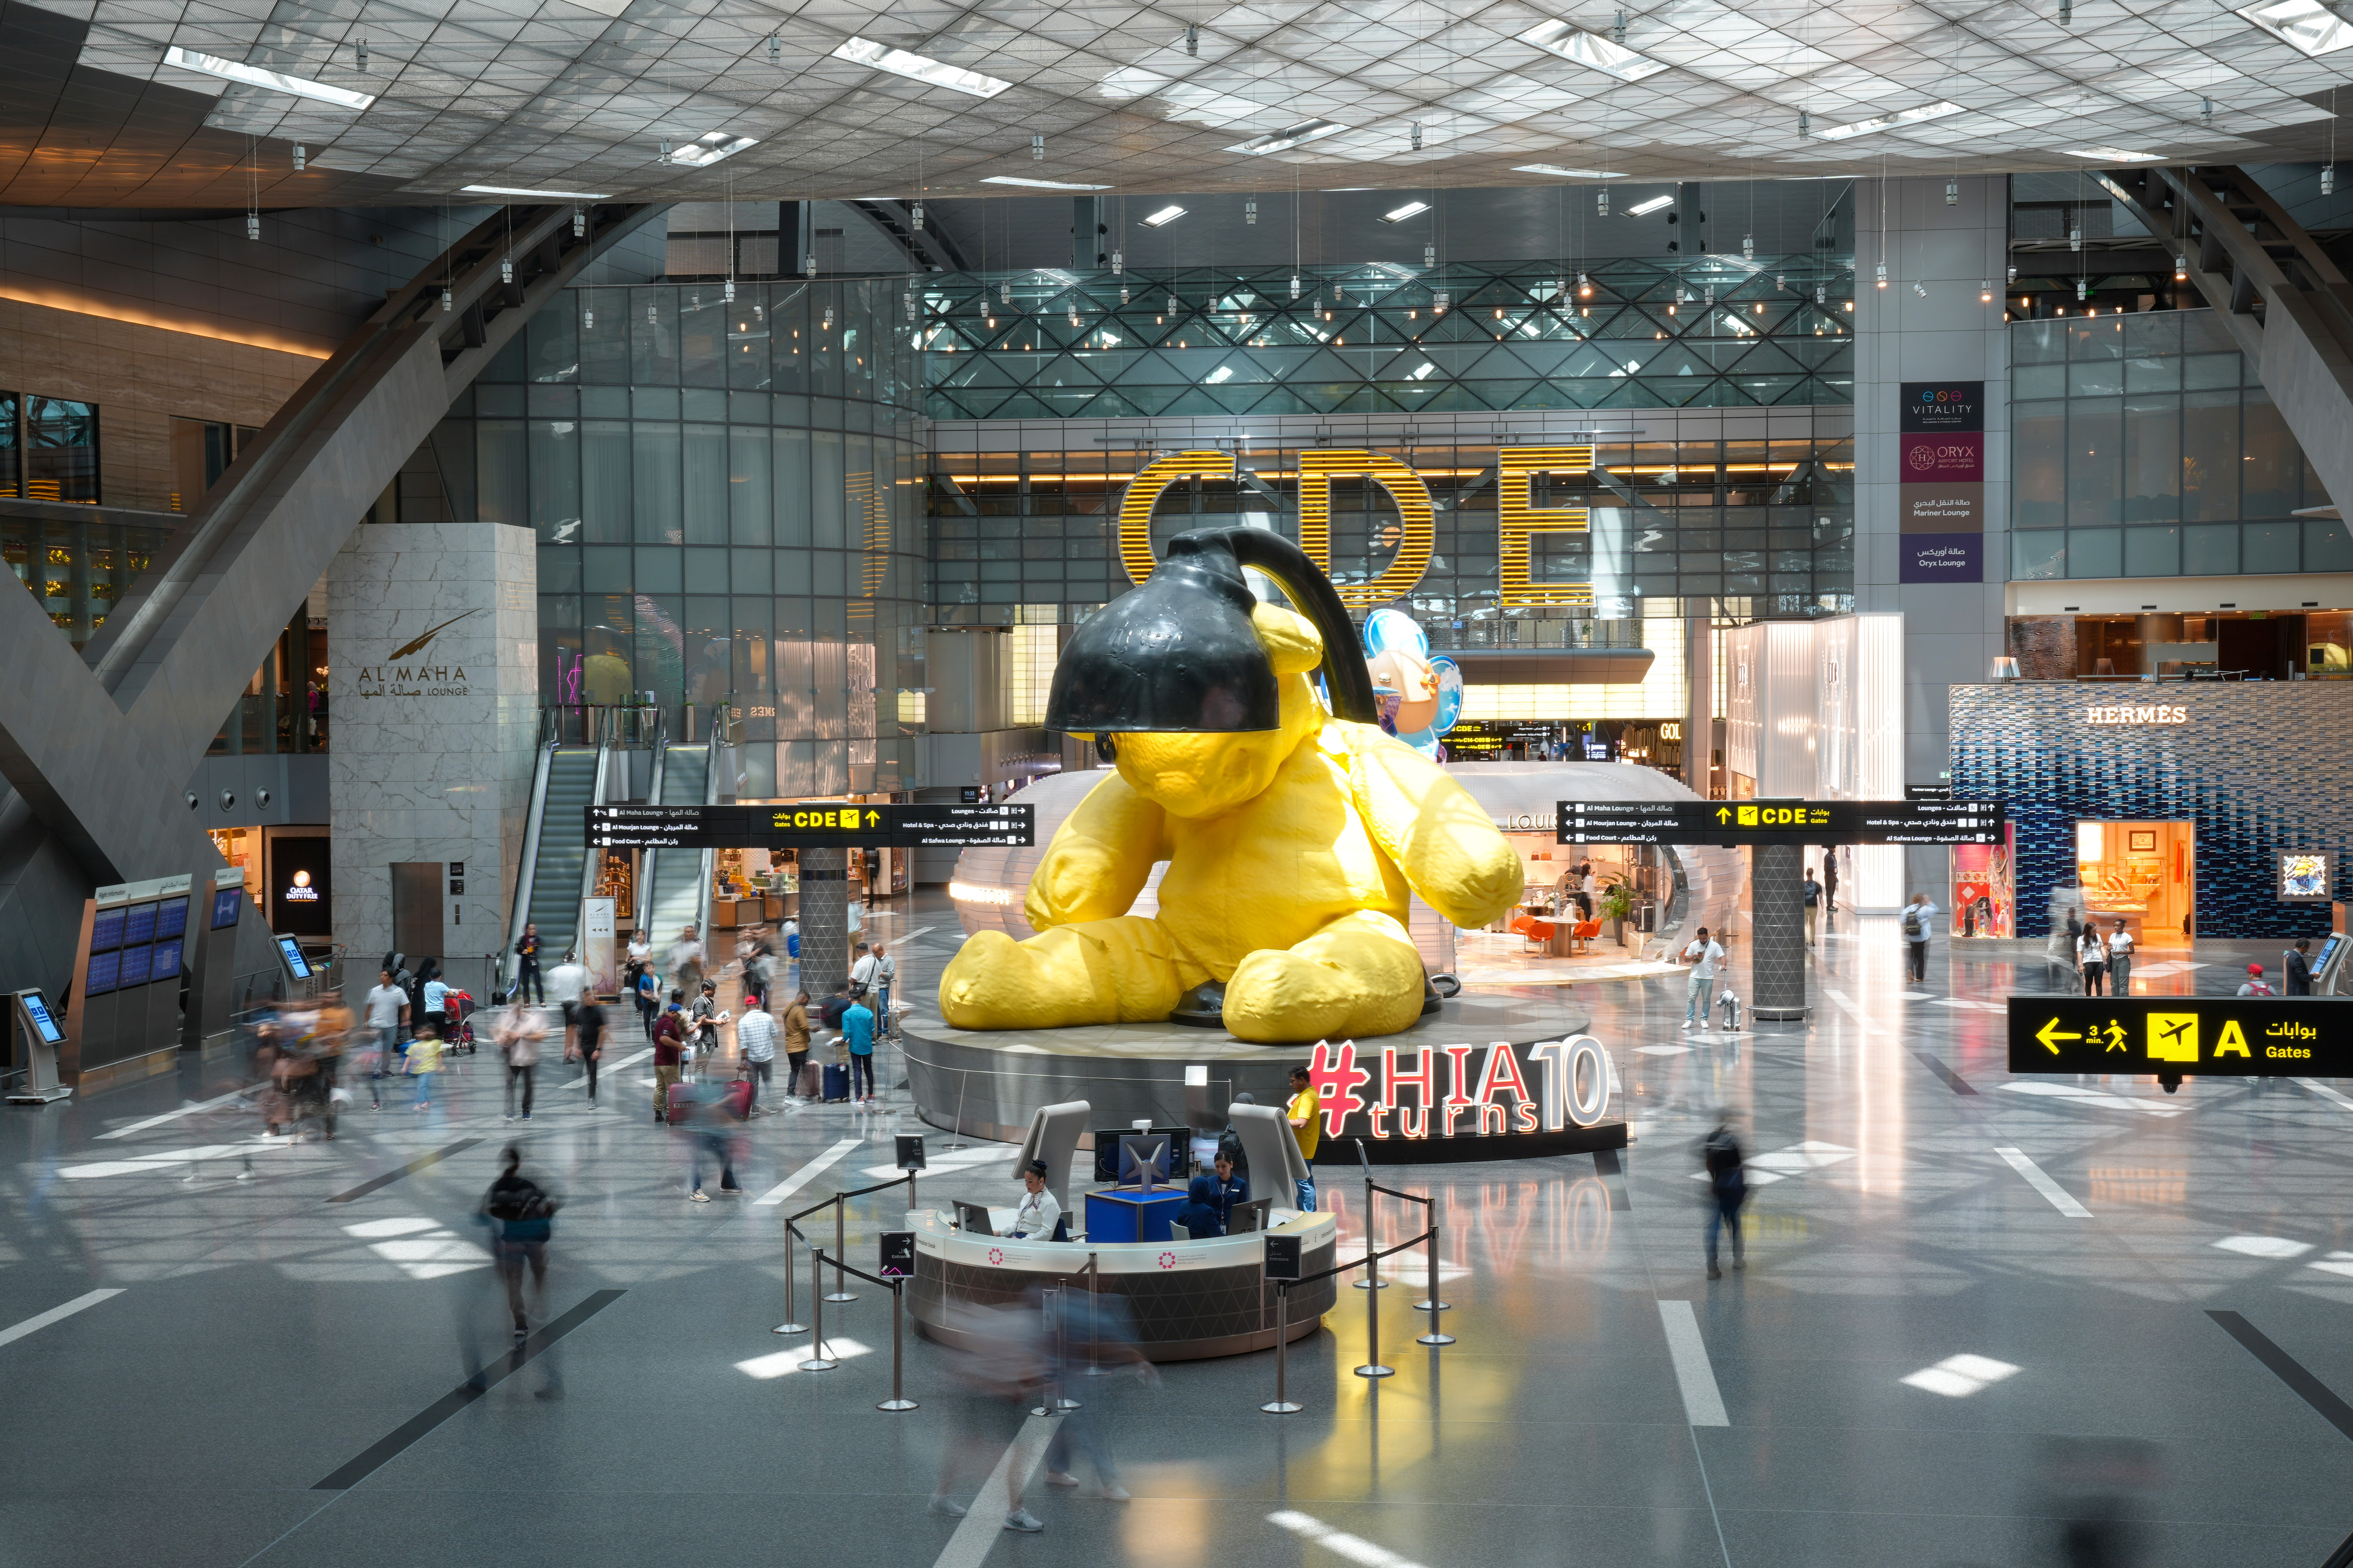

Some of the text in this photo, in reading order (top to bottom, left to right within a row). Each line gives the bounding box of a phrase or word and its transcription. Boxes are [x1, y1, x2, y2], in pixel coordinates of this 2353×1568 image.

[1913, 405, 1972, 414] VITALITY
[1937, 446, 1974, 457] ORYX
[1914, 500, 1935, 509] البحري
[1917, 546, 1947, 557] أوريكس
[1919, 560, 1937, 568] Oryx
[359, 666, 467, 682] AL MAHA
[359, 684, 421, 700] صالة المها
[428, 688, 468, 696] LOUNGE
[1661, 723, 1681, 740] GOL
[669, 809, 683, 817] المها
[1640, 805, 1655, 813] المها
[794, 812, 836, 827] CDE
[1762, 808, 1806, 824] CDE
[956, 822, 972, 830] ونادي
[973, 821, 988, 830] فندق
[1923, 819, 1939, 827] ونادي
[1940, 818, 1956, 827] فندق
[2089, 1025, 2098, 1036] 3
[2266, 1022, 2316, 1040] بوابات
[2213, 1020, 2251, 1057] A
[2266, 1046, 2311, 1058] Gates
[1527, 1034, 1610, 1131] 10
[1368, 1100, 1538, 1139] turns
